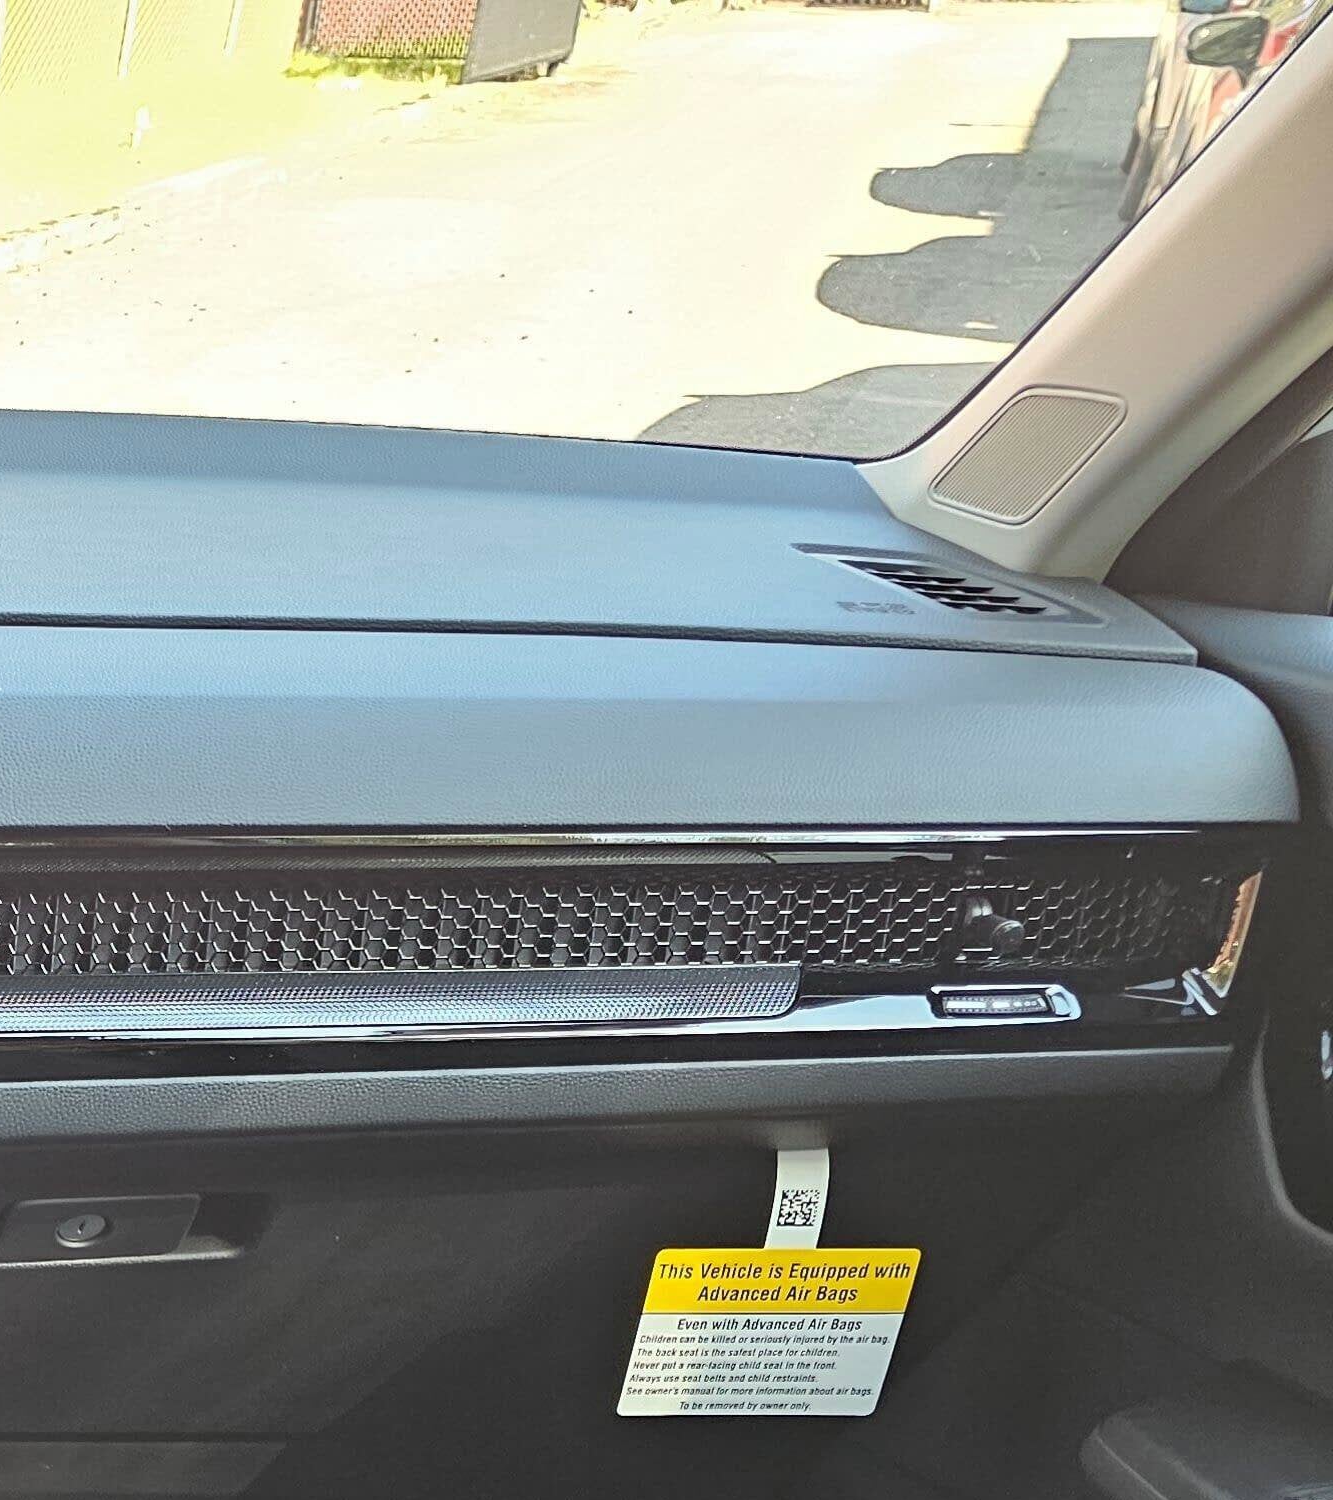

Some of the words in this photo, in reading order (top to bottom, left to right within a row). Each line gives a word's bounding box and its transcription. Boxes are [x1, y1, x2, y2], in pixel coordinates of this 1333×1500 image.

[659, 1263, 694, 1279] This
[701, 1263, 763, 1279] Vehicle
[768, 1263, 784, 1279] is
[789, 1262, 870, 1282] Equipped
[874, 1262, 911, 1279] with
[697, 1285, 782, 1301] Advanced
[785, 1285, 812, 1301] Air
[816, 1285, 859, 1304] Bags
[677, 1318, 707, 1330] Even
[712, 1318, 739, 1330] with
[741, 1318, 805, 1331] Advanced
[807, 1318, 829, 1330] Air
[830, 1318, 863, 1332] Bags
[639, 1335, 678, 1344] Children
[679, 1336, 695, 1344] can
[697, 1335, 709, 1344] be
[711, 1335, 736, 1344] killed
[737, 1336, 749, 1344] or
[749, 1335, 791, 1347] seriously
[792, 1335, 825, 1347] injured
[827, 1335, 838, 1347] by
[839, 1335, 854, 1344] the
[855, 1335, 869, 1344] air
[870, 1335, 891, 1346] bag.
[637, 1349, 653, 1357] The
[655, 1349, 676, 1357] back
[679, 1349, 699, 1357] seat
[700, 1348, 709, 1357] is
[711, 1348, 726, 1357] the
[728, 1348, 756, 1357] safest
[757, 1348, 783, 1359] place
[785, 1348, 798, 1357] for
[800, 1348, 841, 1357] children.
[633, 1361, 660, 1370] Never
[661, 1361, 677, 1371] put
[686, 1361, 737, 1371] rear-facing
[738, 1361, 761, 1370] child
[763, 1361, 783, 1370] seat
[785, 1361, 794, 1370] in
[796, 1361, 811, 1370] the
[813, 1361, 838, 1370] front.
[629, 1374, 661, 1384] Always
[663, 1375, 680, 1383] use
[682, 1374, 702, 1383] seat
[704, 1374, 726, 1383] belts
[728, 1374, 745, 1383] and
[747, 1374, 771, 1383] child
[772, 1374, 818, 1383] restraints.
[626, 1387, 643, 1396] See
[644, 1387, 679, 1396] owner's
[681, 1387, 715, 1396] manual
[716, 1387, 730, 1396] for
[731, 1388, 754, 1396] more
[755, 1387, 807, 1396] information
[809, 1387, 834, 1396] about
[836, 1387, 849, 1396] air
[850, 1387, 875, 1398] bags.
[679, 1402, 690, 1411] To
[691, 1401, 703, 1410] be
[704, 1401, 744, 1410] removed
[747, 1401, 758, 1412] by
[759, 1402, 788, 1410] owner
[789, 1401, 812, 1412] only.
